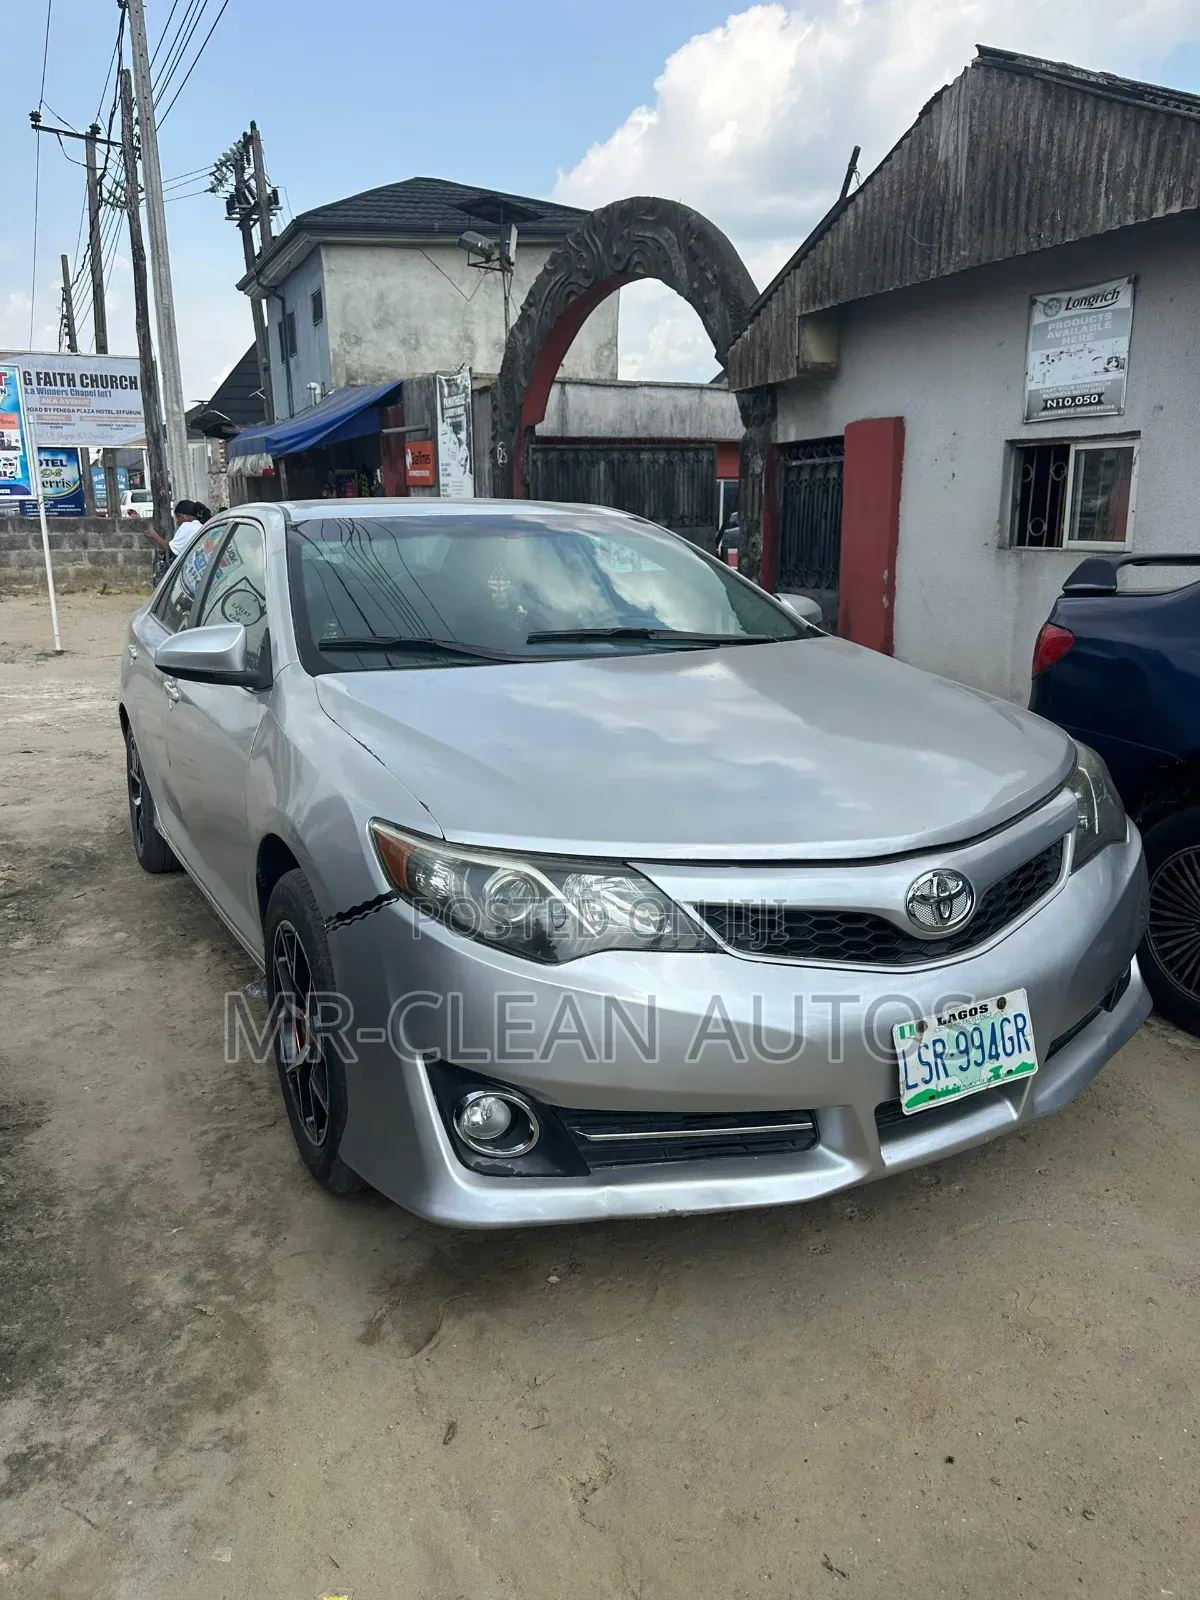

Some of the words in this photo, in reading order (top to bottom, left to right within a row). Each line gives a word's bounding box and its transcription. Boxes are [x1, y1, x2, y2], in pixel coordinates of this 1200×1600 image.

[1065, 288, 1120, 311] Longrich
[1046, 320, 1113, 340] AVAILABLE
[1048, 312, 1113, 331] PRODUCTS
[1062, 332, 1095, 345] HERE
[36, 371, 77, 388] FAITH
[80, 373, 138, 390] CHURCH
[37, 388, 69, 396] Winners
[70, 390, 96, 398] Chapel
[60, 398, 90, 406] AVENUE
[1047, 394, 1099, 408] N10,050
[936, 1003, 989, 1026] LAGOS
[901, 1013, 1031, 1091] LSR-994GR
